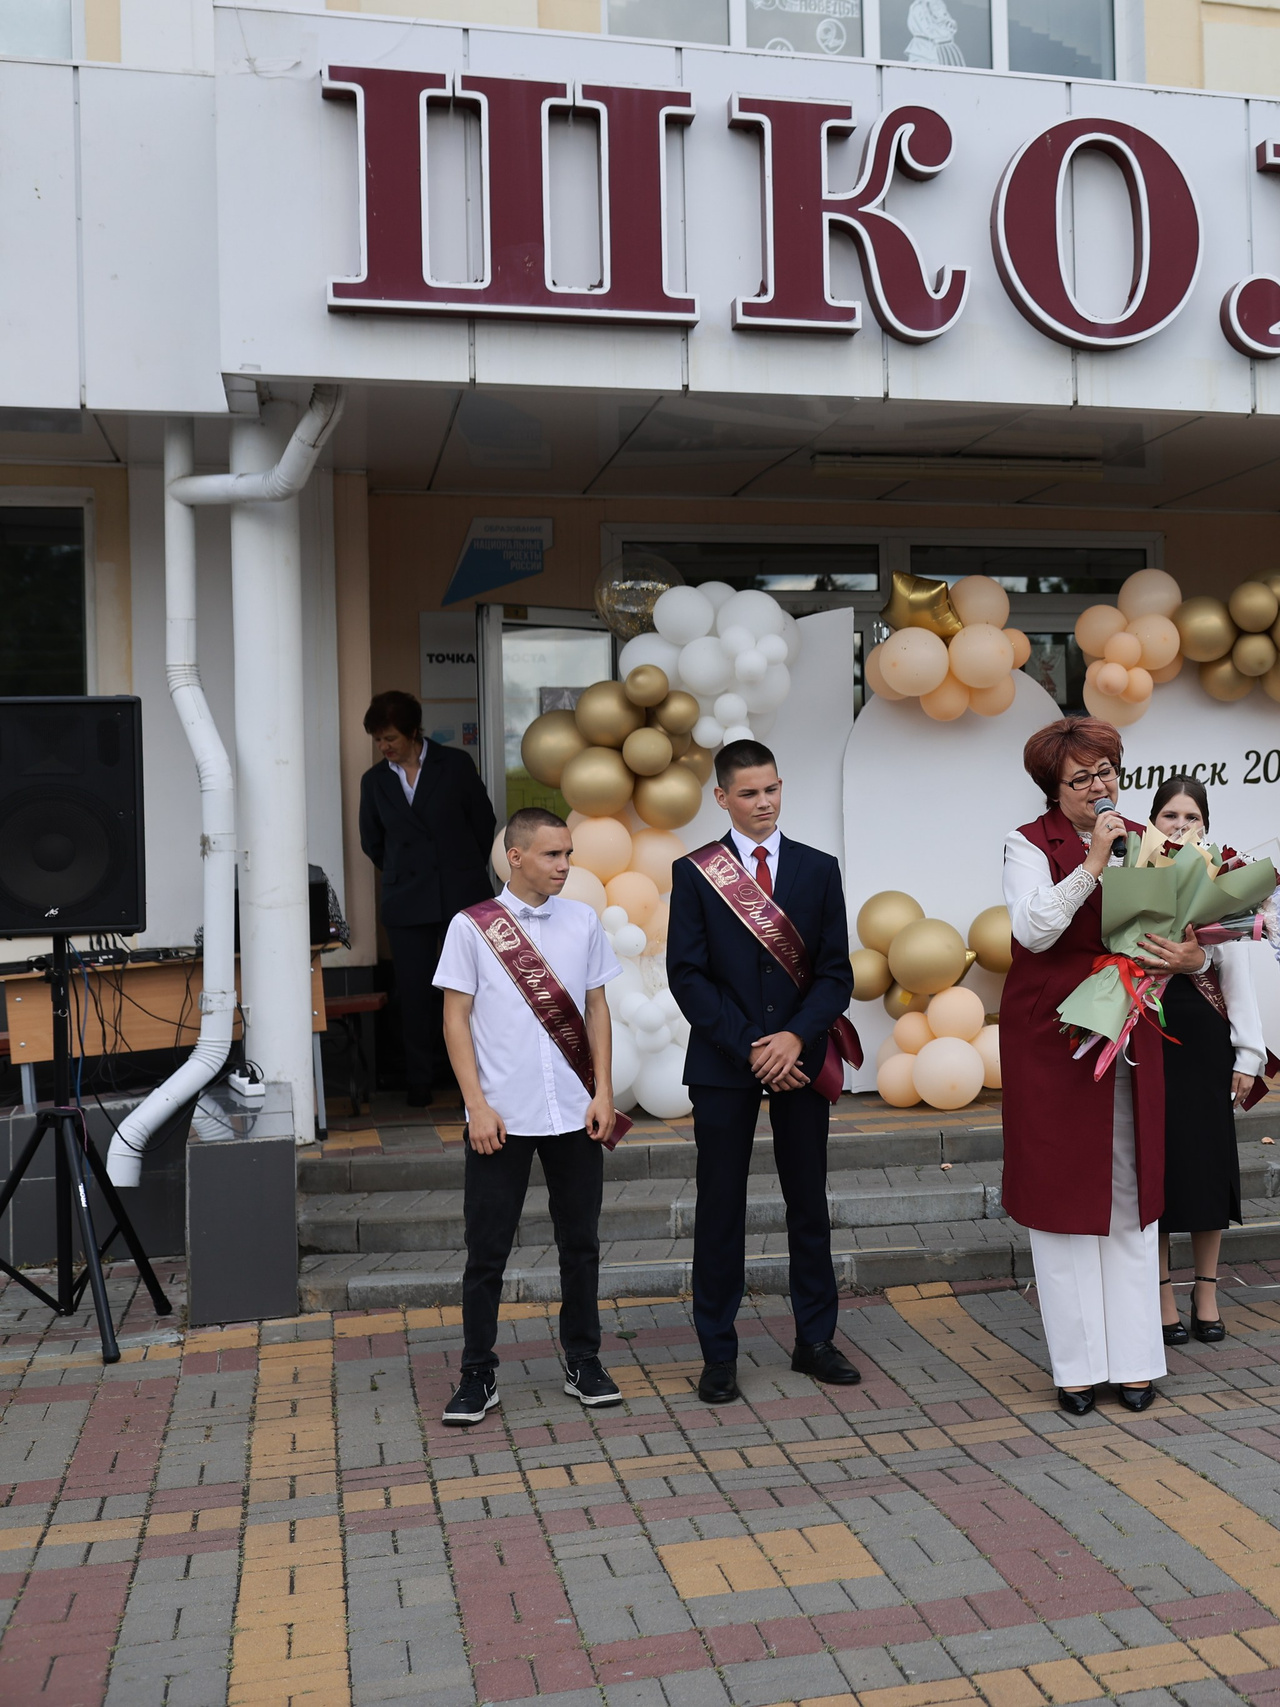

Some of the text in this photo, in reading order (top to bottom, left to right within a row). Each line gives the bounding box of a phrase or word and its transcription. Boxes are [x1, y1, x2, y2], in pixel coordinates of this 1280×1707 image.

[483, 524, 543, 533] ОБРАЗОВАНИЕ
[473, 540, 542, 550] НАЦИОНАЛЬНЫЕ
[503, 550, 542, 561] ПРОЕКТЫ
[510, 561, 542, 571] РОССИИ
[427, 652, 475, 664] ТОЧКА
[512, 949, 581, 1050] Выпускник
